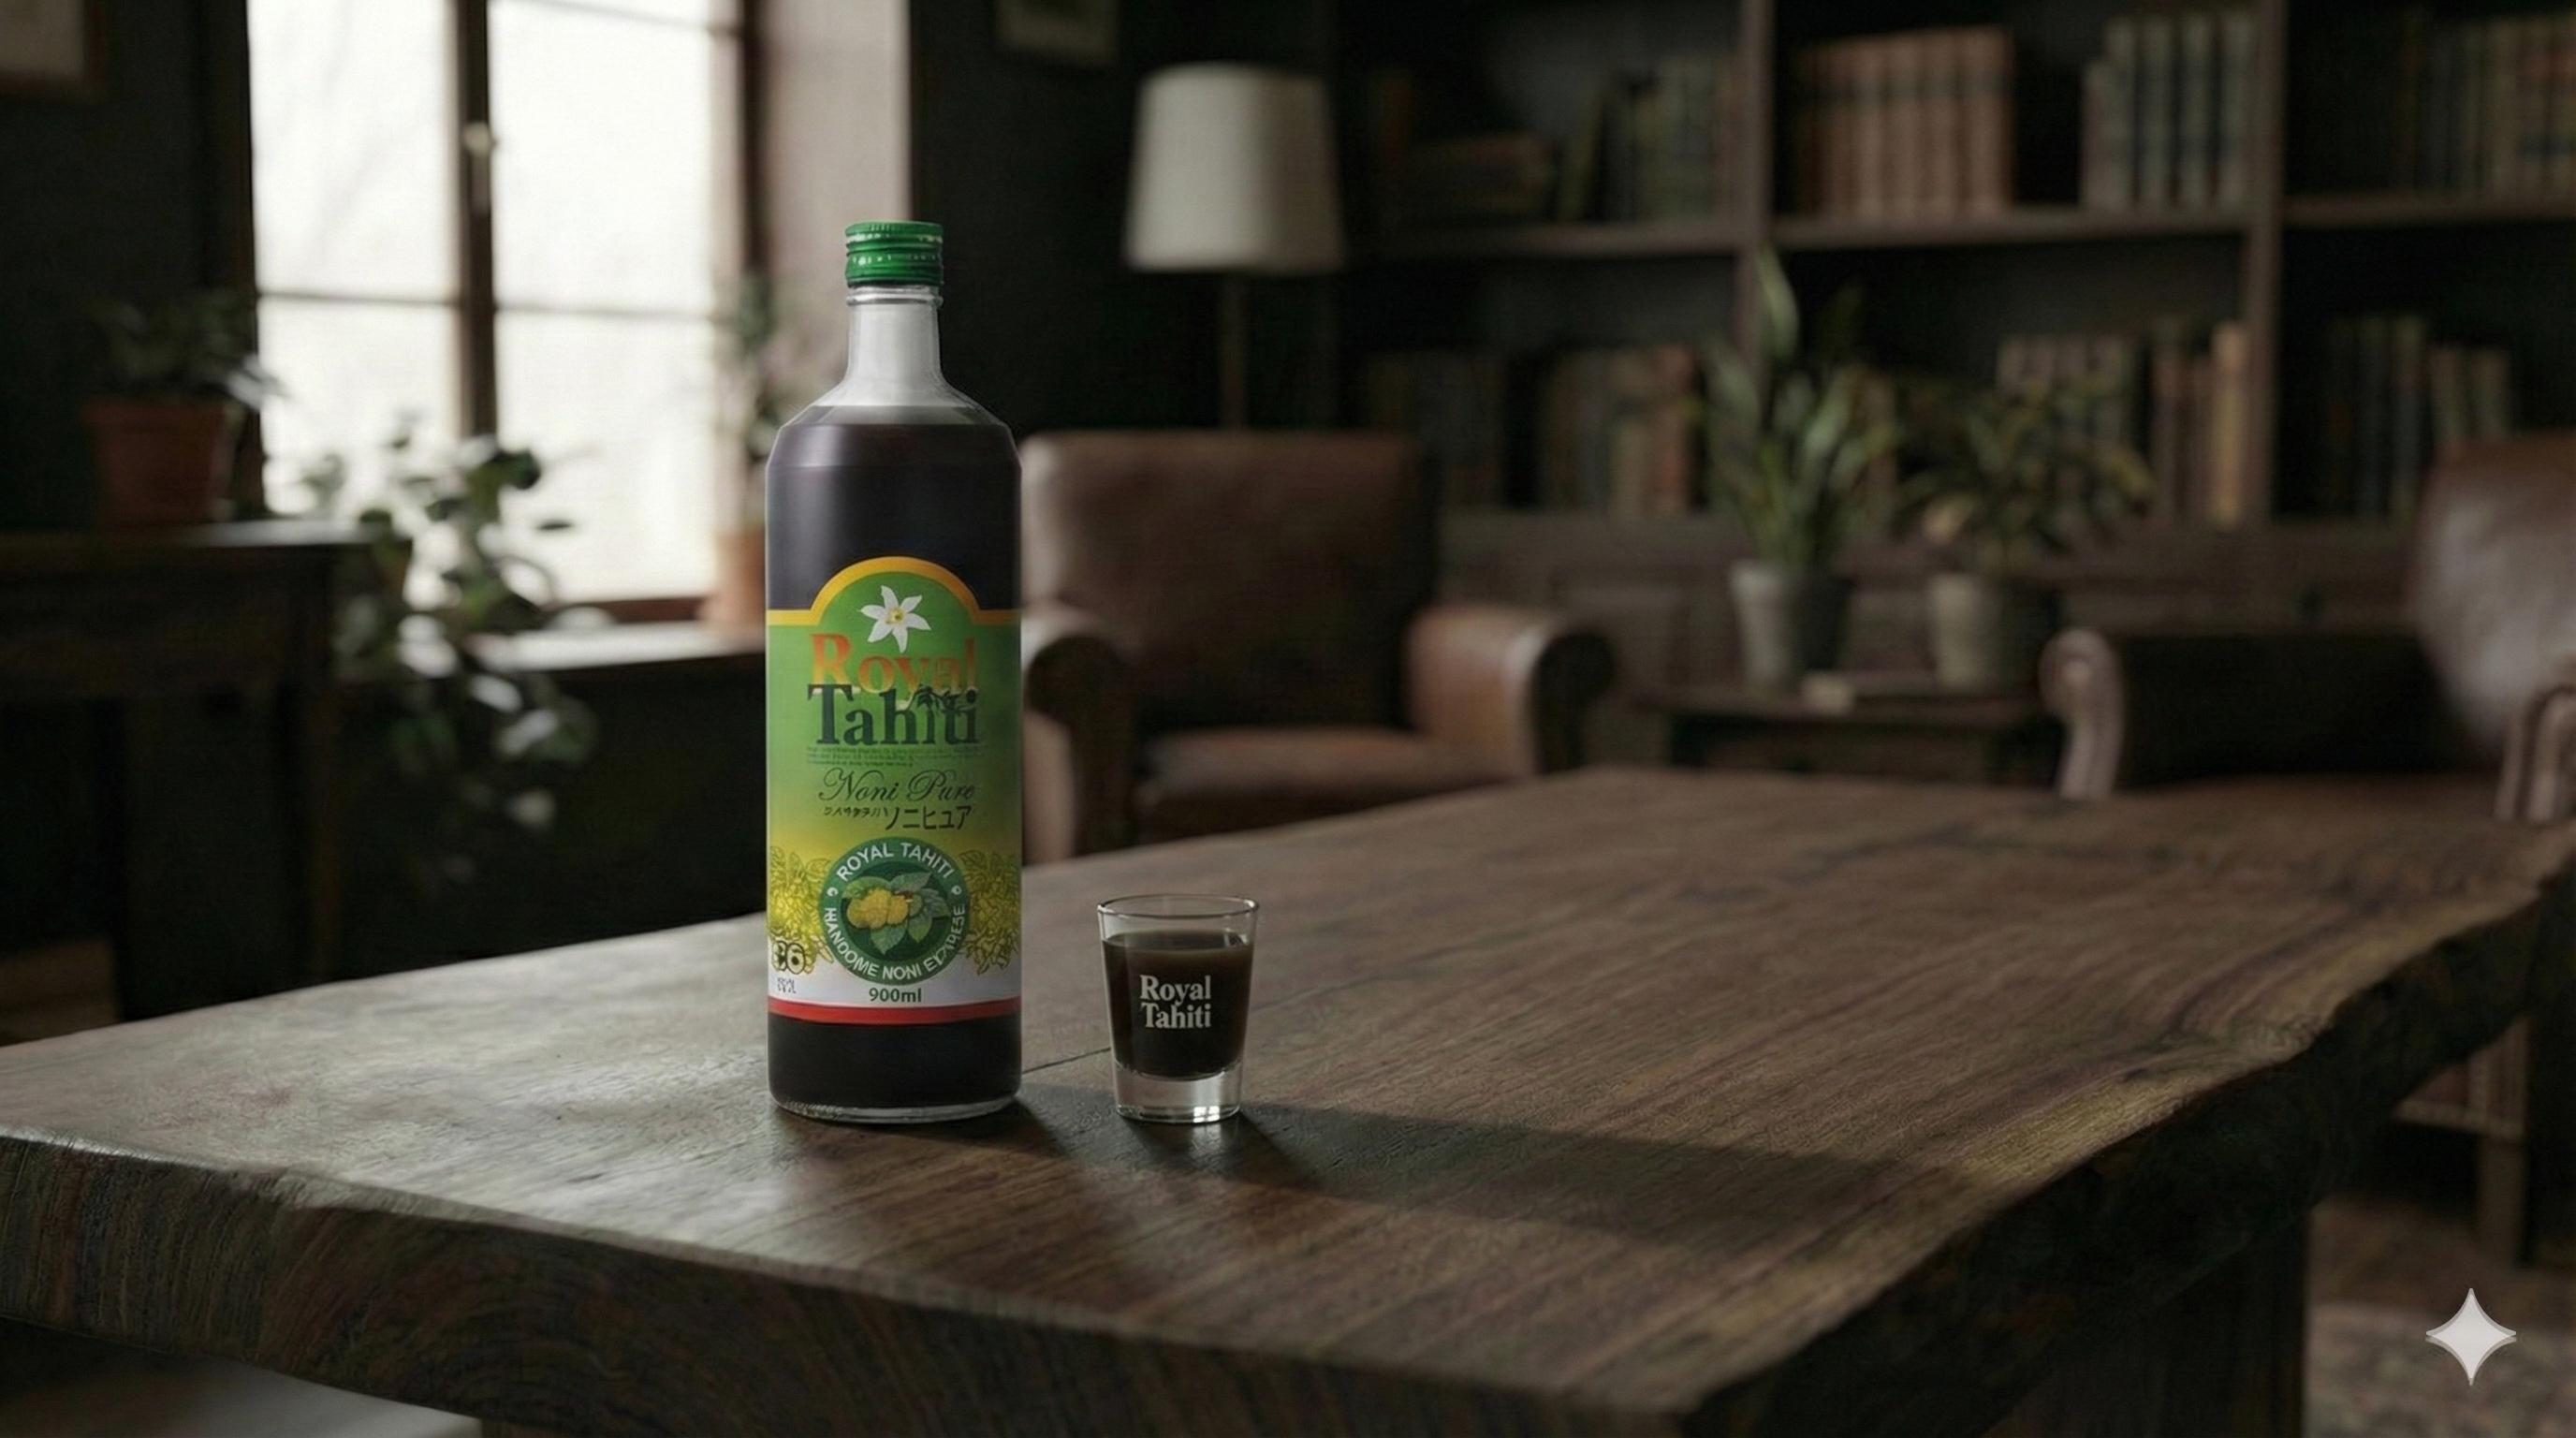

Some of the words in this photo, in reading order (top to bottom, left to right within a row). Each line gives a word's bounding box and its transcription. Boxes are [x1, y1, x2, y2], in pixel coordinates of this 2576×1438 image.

[810, 633, 976, 709] Royal
[807, 684, 980, 745] Tahiti
[818, 768, 900, 801] Noni
[907, 769, 975, 802] Pure
[836, 843, 894, 882] ROYAL
[900, 843, 955, 879] TAHITI
[882, 962, 923, 980] NONI
[869, 987, 922, 1003] 900ml
[1139, 975, 1211, 1006] Royal
[1140, 1002, 1211, 1029] Tahiti
